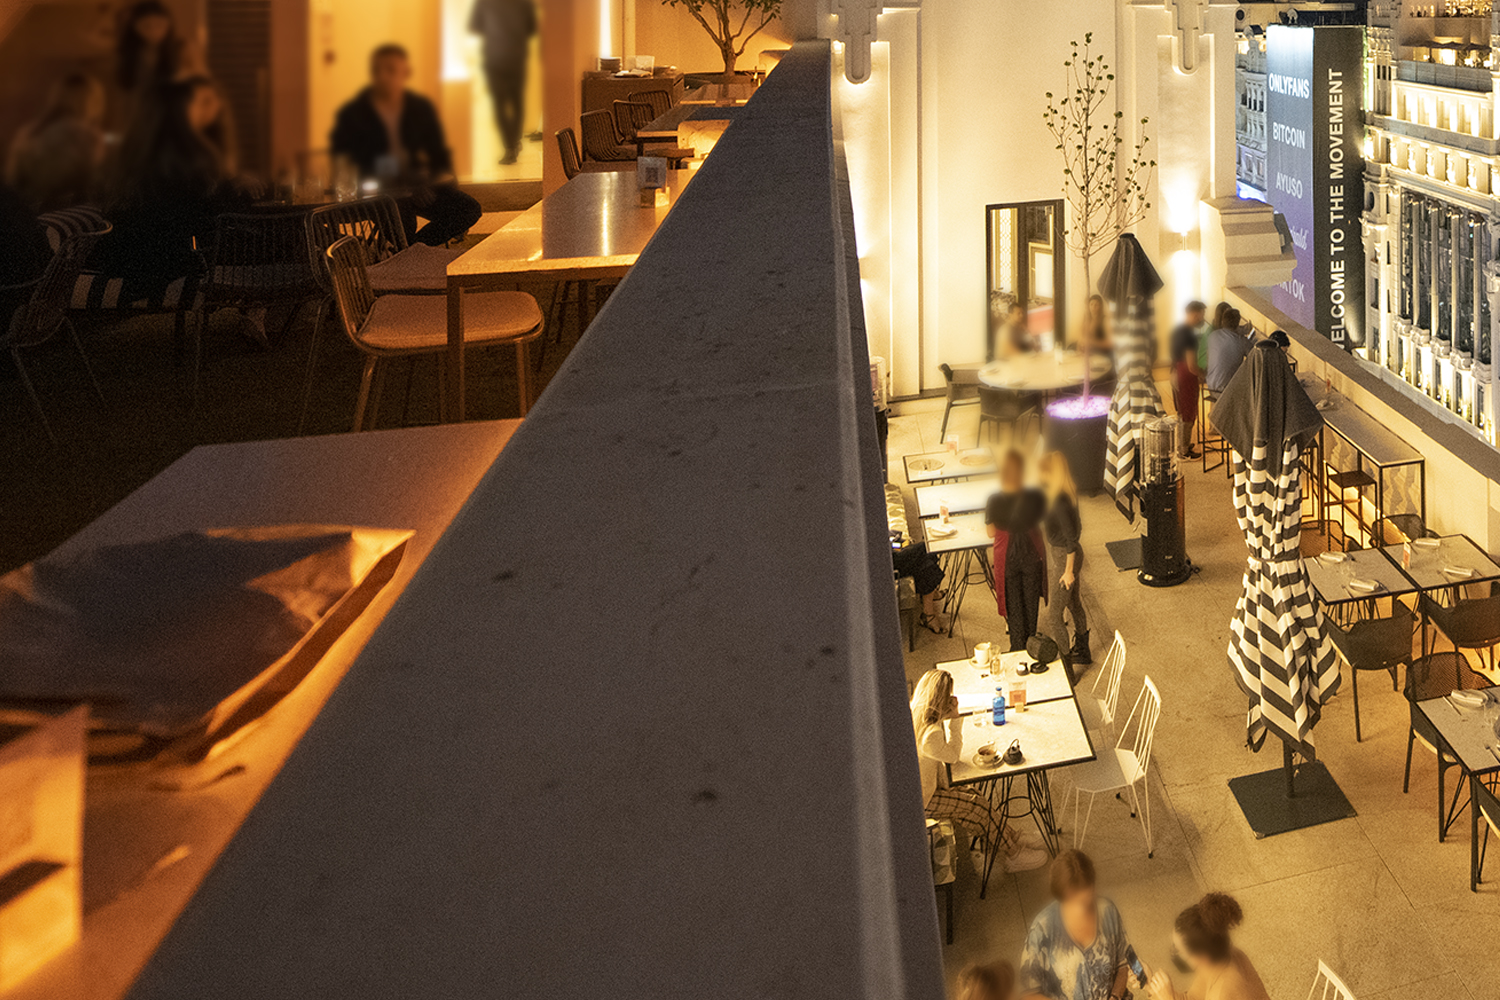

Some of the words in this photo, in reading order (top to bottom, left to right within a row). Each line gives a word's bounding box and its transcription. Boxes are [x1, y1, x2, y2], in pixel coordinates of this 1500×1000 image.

[1268, 72, 1310, 100] ONLYFANS
[1272, 121, 1306, 150] BITCOIN
[1328, 68, 1344, 179] MOVEMENT
[1275, 171, 1303, 199] AYUSO
[1329, 185, 1344, 224] THE
[1330, 228, 1345, 256] TO
[1330, 260, 1346, 350] ELCOME
